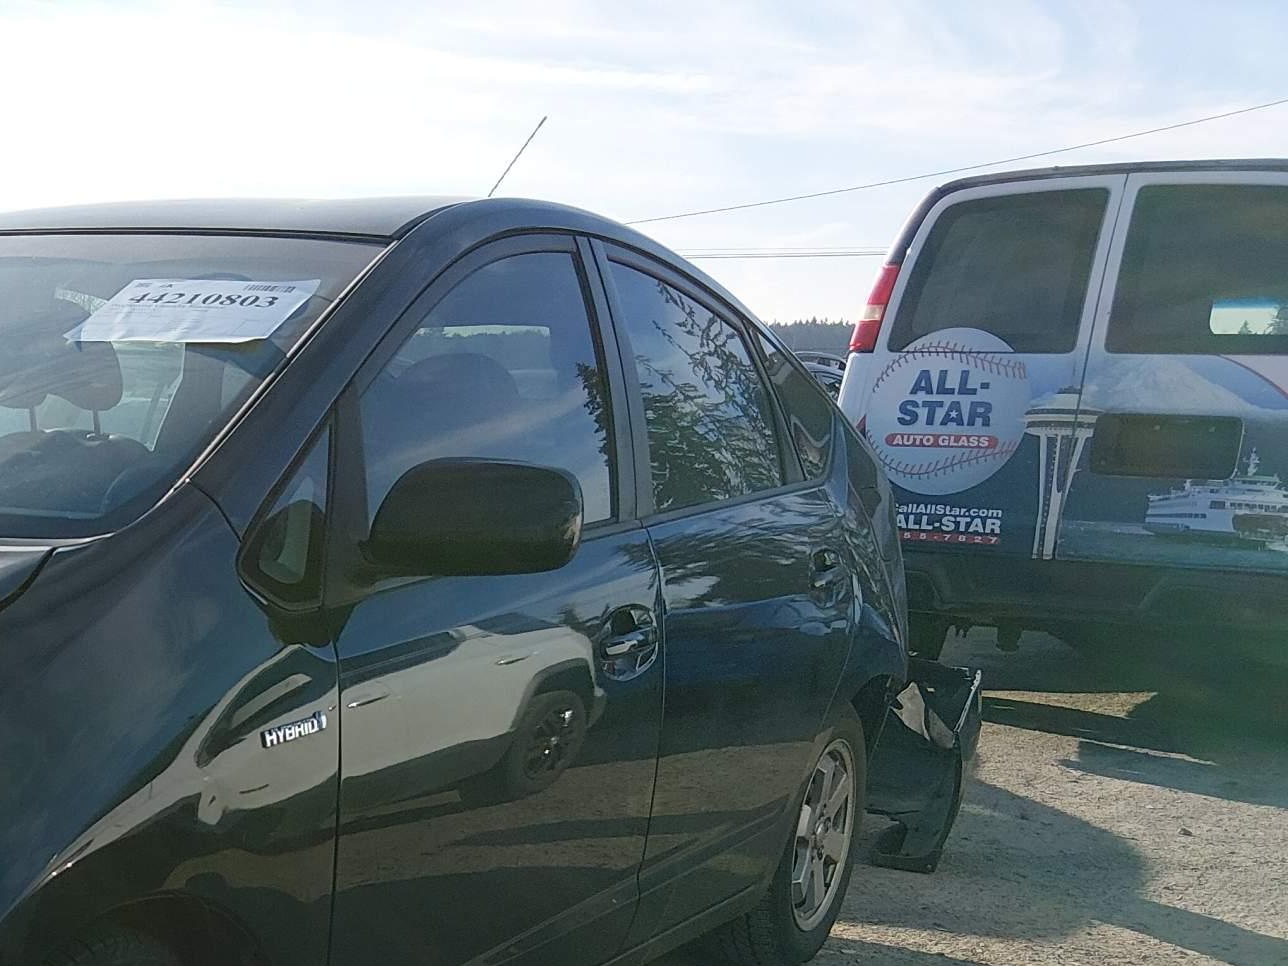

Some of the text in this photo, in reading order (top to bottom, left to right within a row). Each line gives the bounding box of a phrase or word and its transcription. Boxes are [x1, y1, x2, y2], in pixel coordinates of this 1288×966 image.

[129, 292, 279, 309] 44210803
[909, 369, 991, 396] ALL-
[896, 399, 993, 428] STAR
[892, 434, 990, 448] AUTO GLASS
[263, 716, 321, 748] HYBRID
